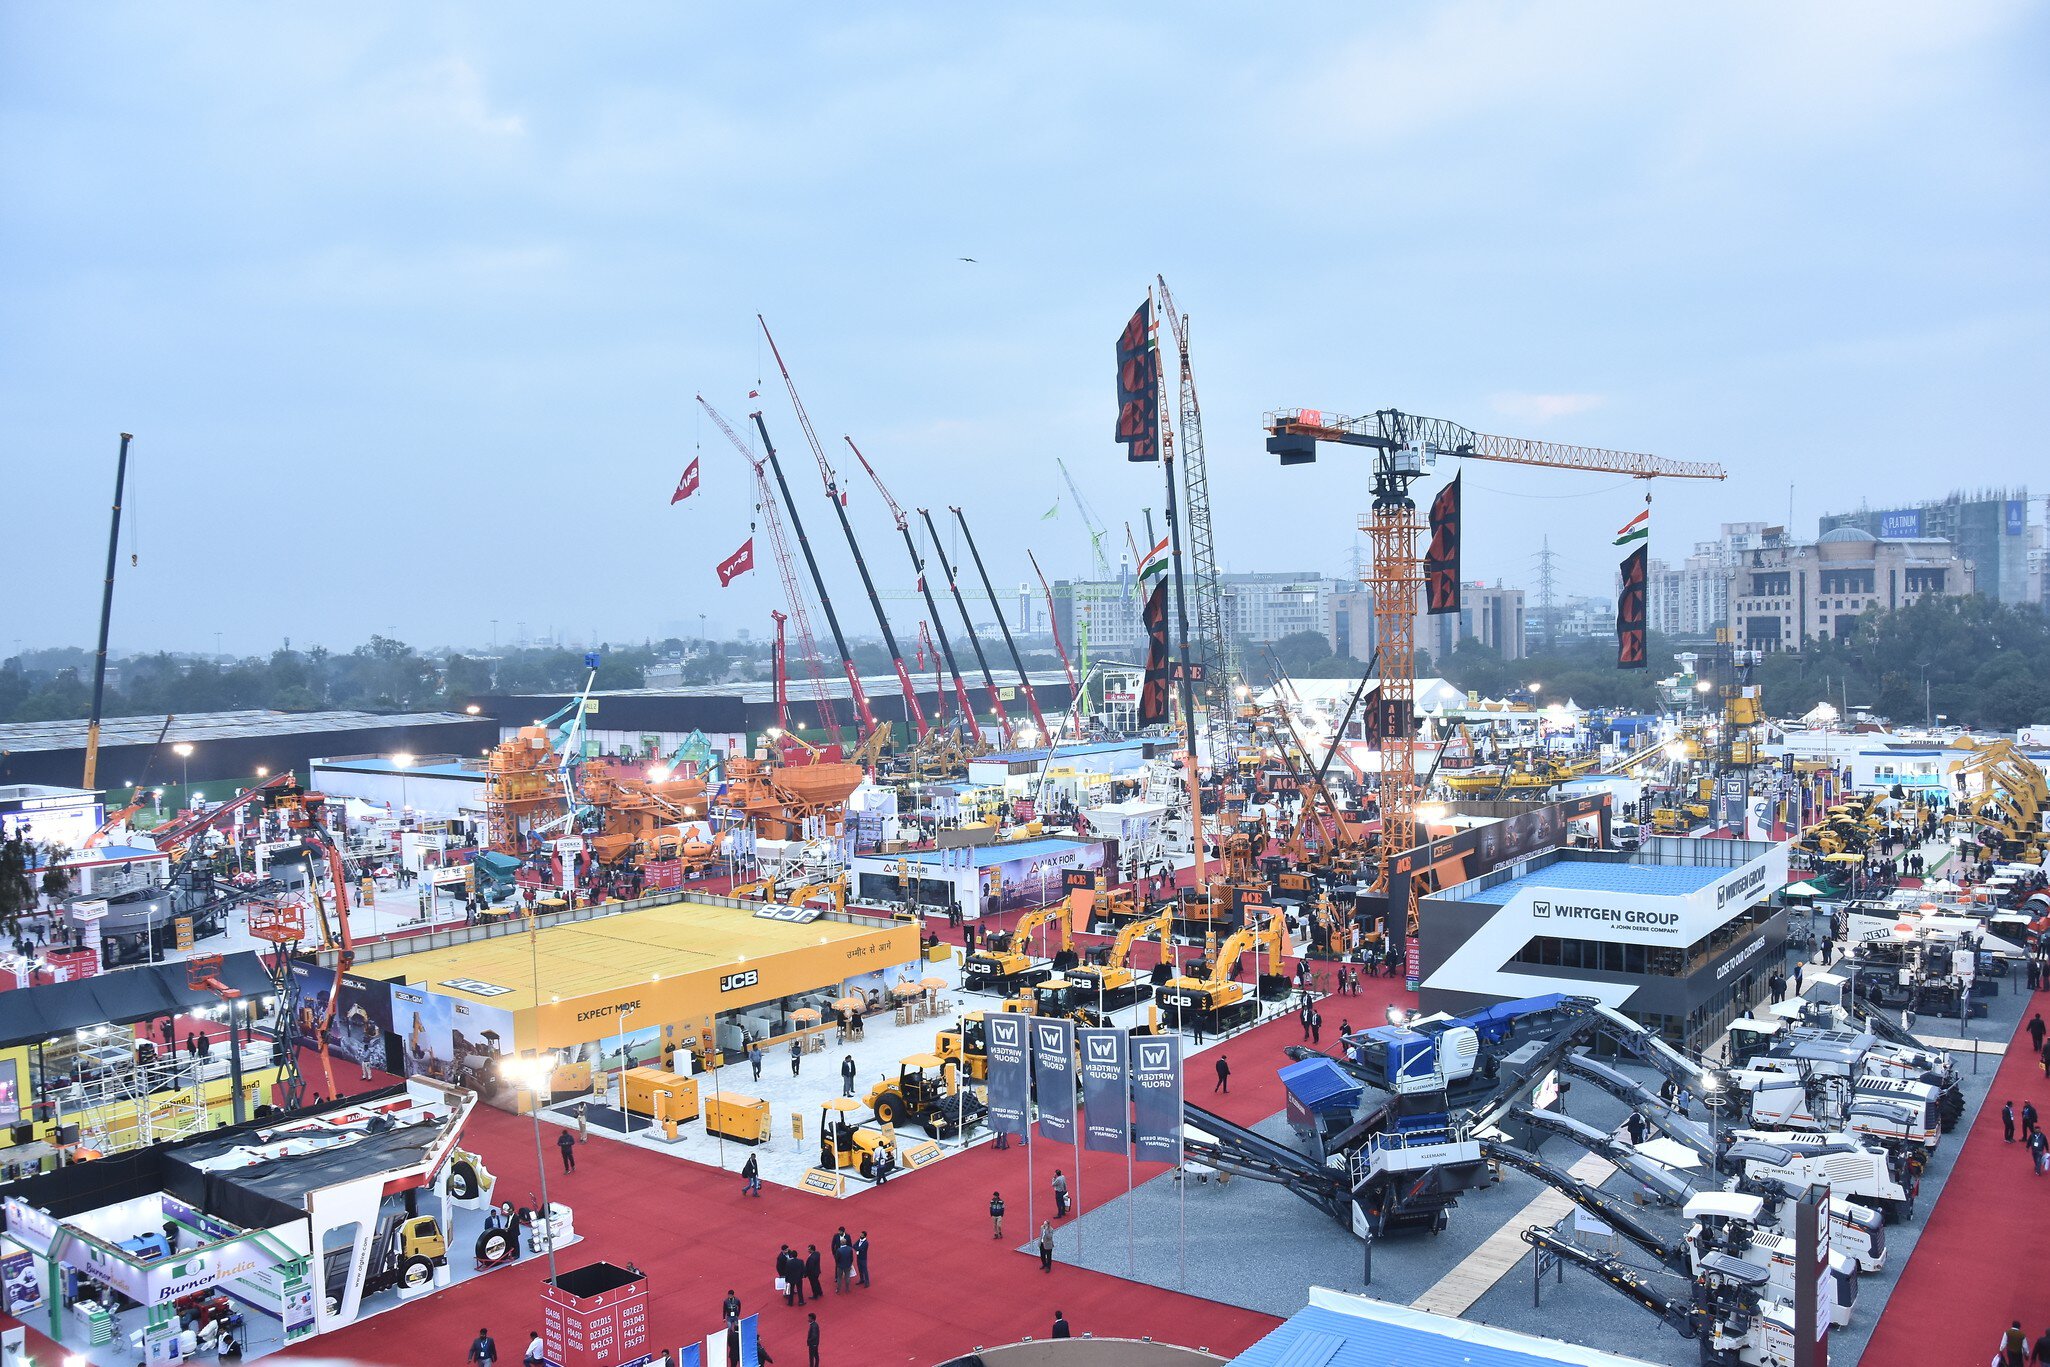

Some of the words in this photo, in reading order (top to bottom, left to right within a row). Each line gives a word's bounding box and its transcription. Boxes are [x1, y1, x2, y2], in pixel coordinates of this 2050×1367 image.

[1888, 514, 1917, 529] PLATINUM
[1173, 665, 1202, 680] AE
[268, 843, 290, 851] TEREX
[69, 852, 96, 860] EREX
[1059, 853, 1076, 865] FIORI
[1067, 873, 1086, 885] ACE
[1241, 892, 1263, 904] ACE
[762, 904, 820, 923] JCB
[1555, 905, 1621, 922] WIRTGEN
[1625, 910, 1679, 926] GROUP
[1863, 928, 1889, 941] NEW
[968, 963, 991, 974] JCB
[1716, 964, 1730, 980] CLOSE
[721, 970, 759, 991] JCB
[1070, 977, 1092, 989] JCB
[441, 978, 509, 996] JCB
[1163, 994, 1192, 1008] JCB
[577, 1005, 613, 1022] EXPECT
[615, 1000, 641, 1014] MORE
[681, 1036, 697, 1047] JCB
[888, 1083, 899, 1091] JCB
[1413, 1083, 1434, 1091] KLEEMANN
[965, 1112, 978, 1122] JCB
[1771, 1168, 1795, 1176] WIRTGEN
[1843, 1234, 1864, 1244] WIRTGEN
[86, 1262, 111, 1282] Burner
[159, 1274, 216, 1300] Burner
[215, 1261, 256, 1280] India
[1775, 1339, 1795, 1349] WIRTG
[597, 1349, 609, 1360] B59
